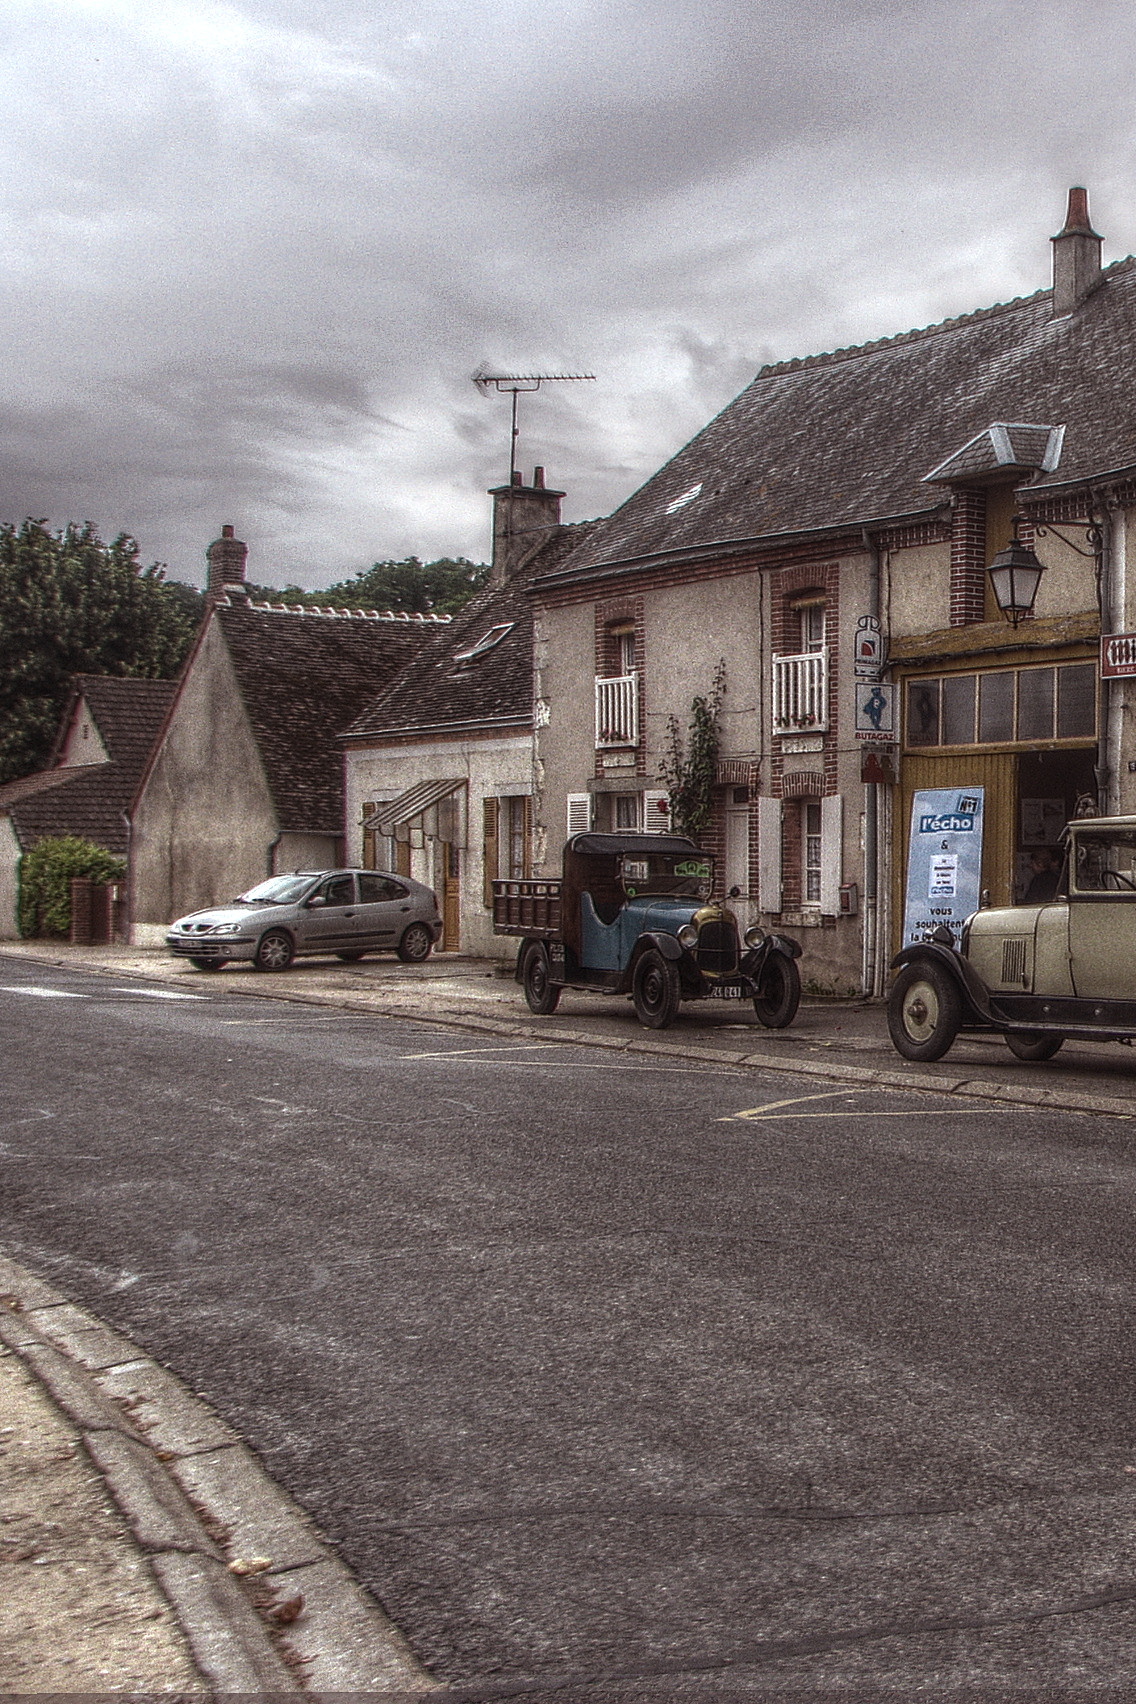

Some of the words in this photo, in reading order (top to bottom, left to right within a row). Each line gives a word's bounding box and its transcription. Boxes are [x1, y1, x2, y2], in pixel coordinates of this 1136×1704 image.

[855, 732, 895, 741] BUTAGAZ
[922, 815, 972, 830] l'écho
[940, 839, 949, 850] &
[930, 907, 953, 916] vous
